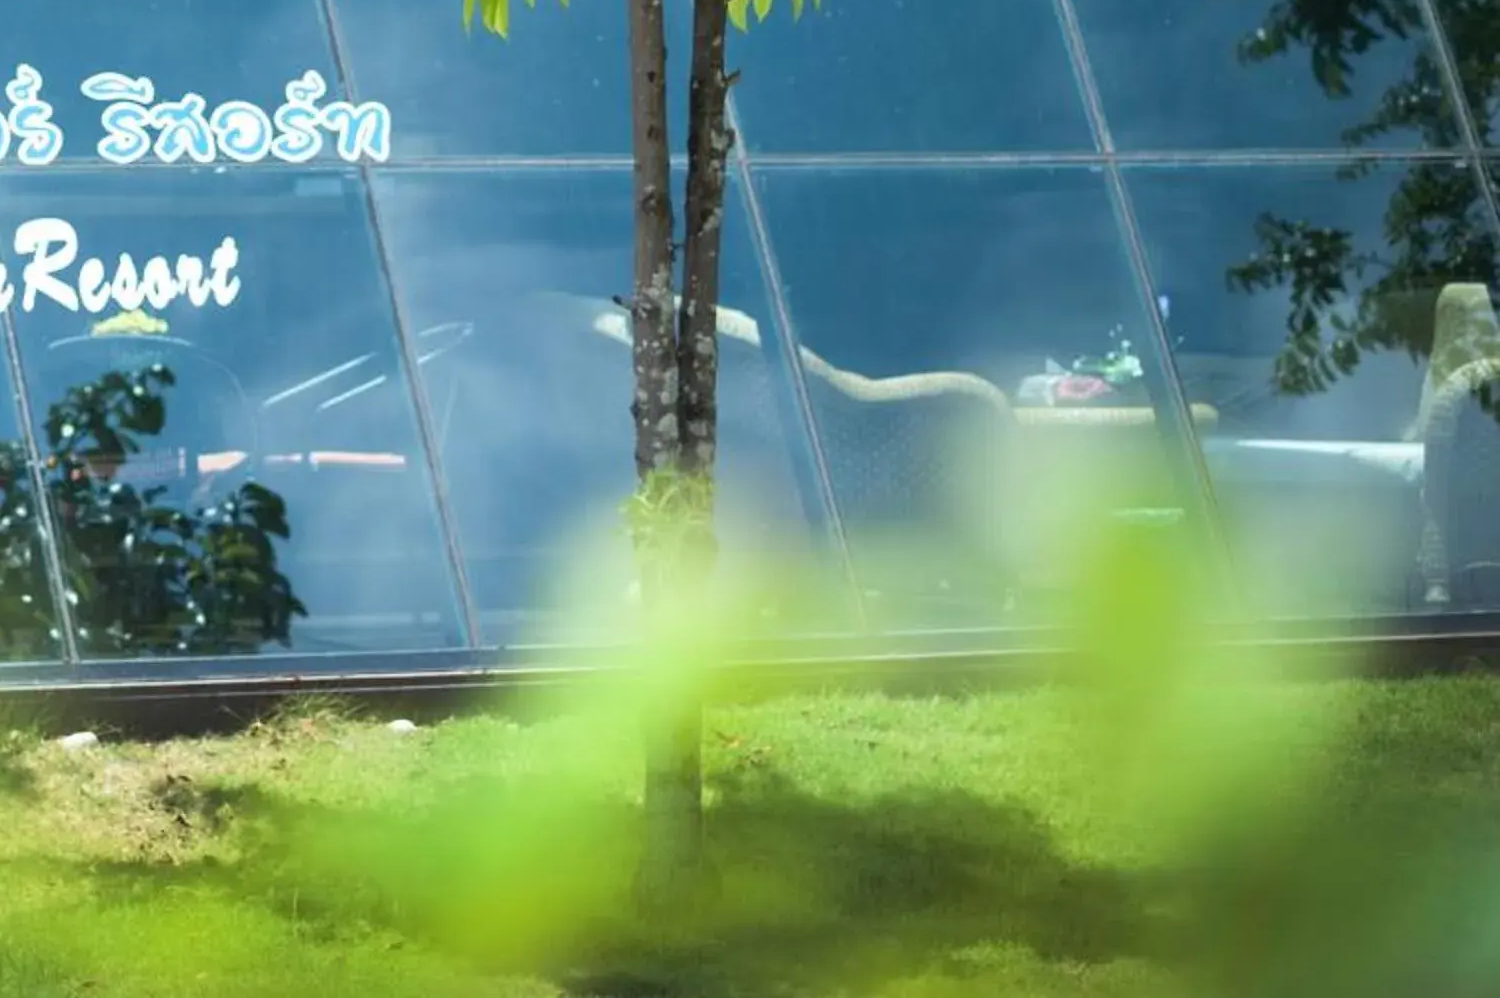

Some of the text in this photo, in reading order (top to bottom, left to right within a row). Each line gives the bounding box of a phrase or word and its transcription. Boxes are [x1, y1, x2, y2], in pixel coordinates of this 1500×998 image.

[81, 69, 391, 164] รีสอร์ท
[13, 217, 242, 313] Resort
